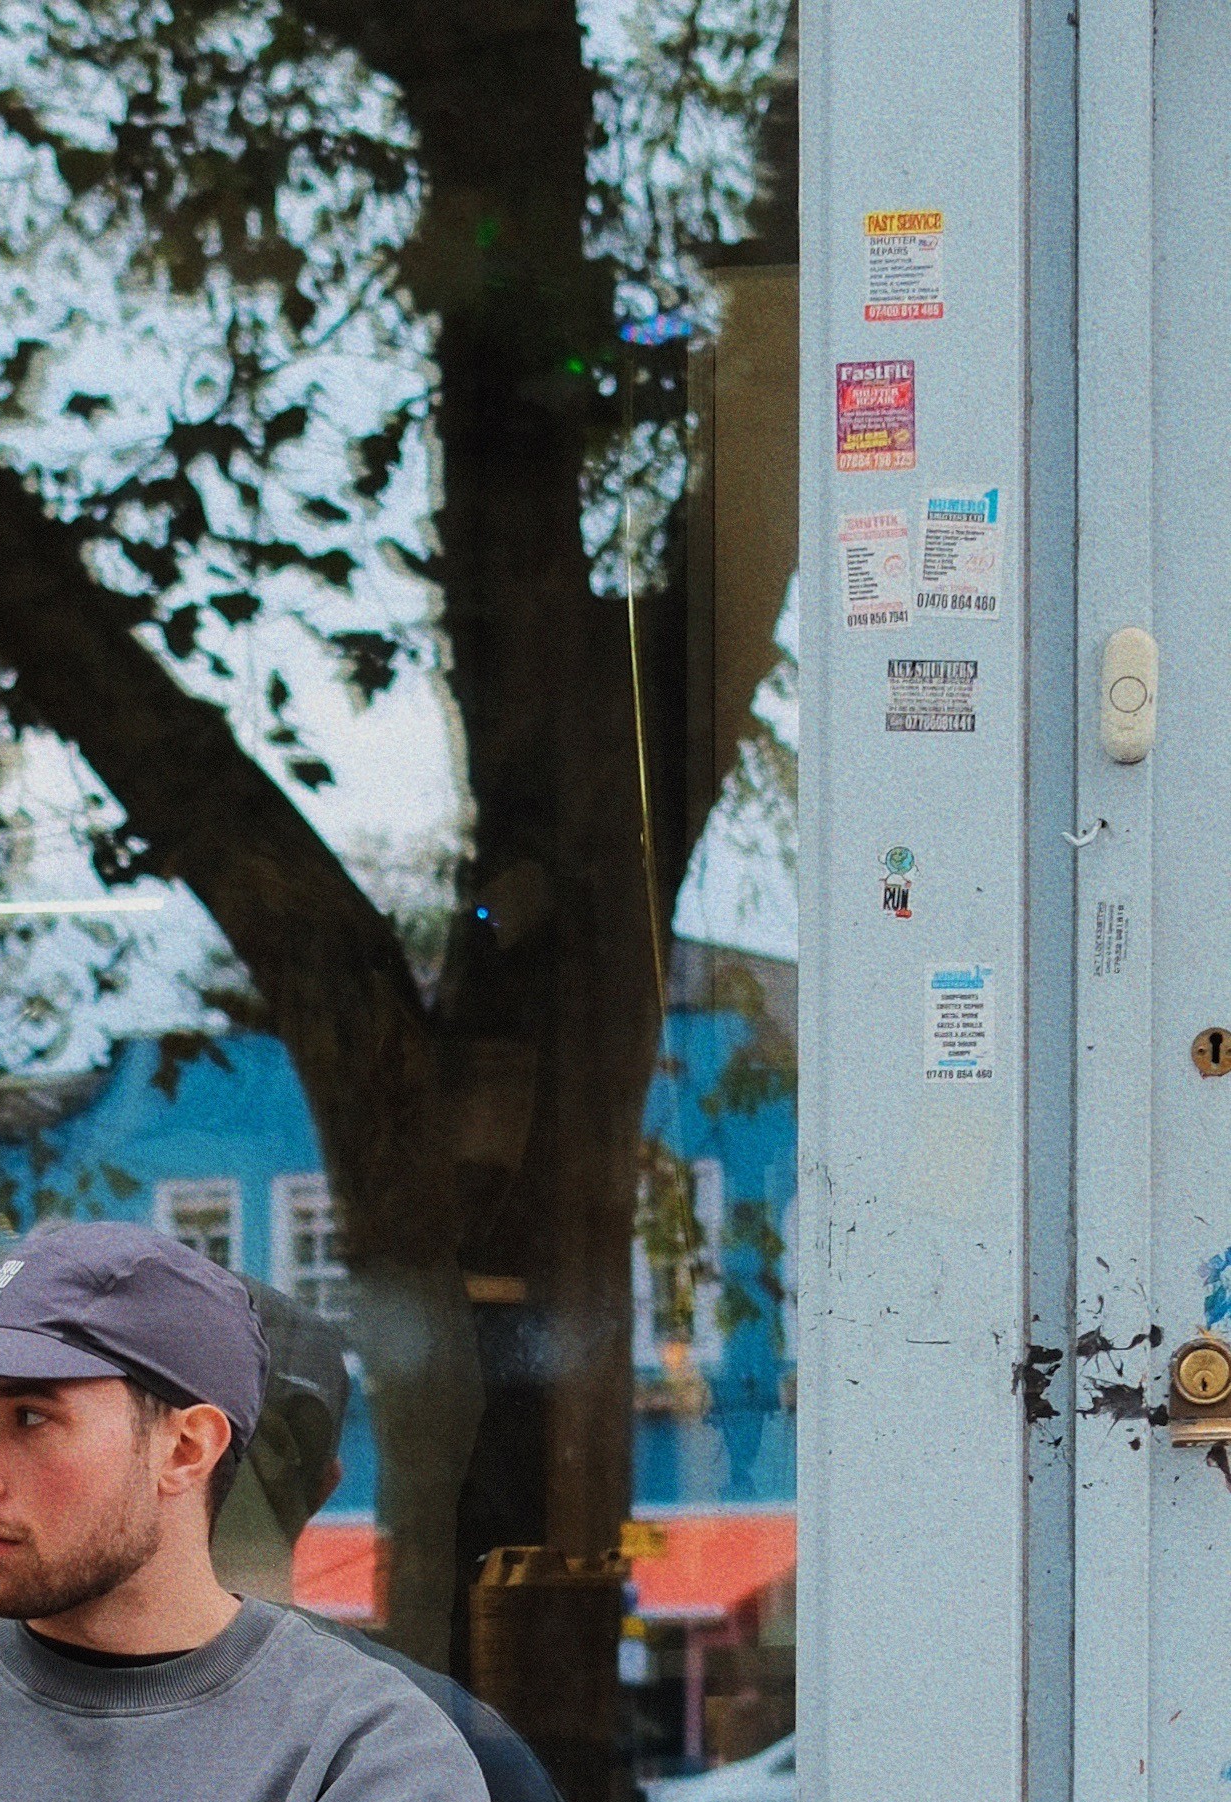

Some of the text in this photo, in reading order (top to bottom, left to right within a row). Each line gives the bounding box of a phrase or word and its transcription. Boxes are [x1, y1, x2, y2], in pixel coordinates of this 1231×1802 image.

[868, 212, 942, 232] FAST SERVICE
[869, 236, 917, 246] SHUTTER
[869, 246, 909, 256] REPAIRS
[840, 364, 910, 381] FastFit
[928, 488, 1000, 525] NUMERO 1
[950, 594, 972, 611] 864
[890, 661, 975, 679] ACE SHUTTERS
[884, 886, 910, 911] RUN
